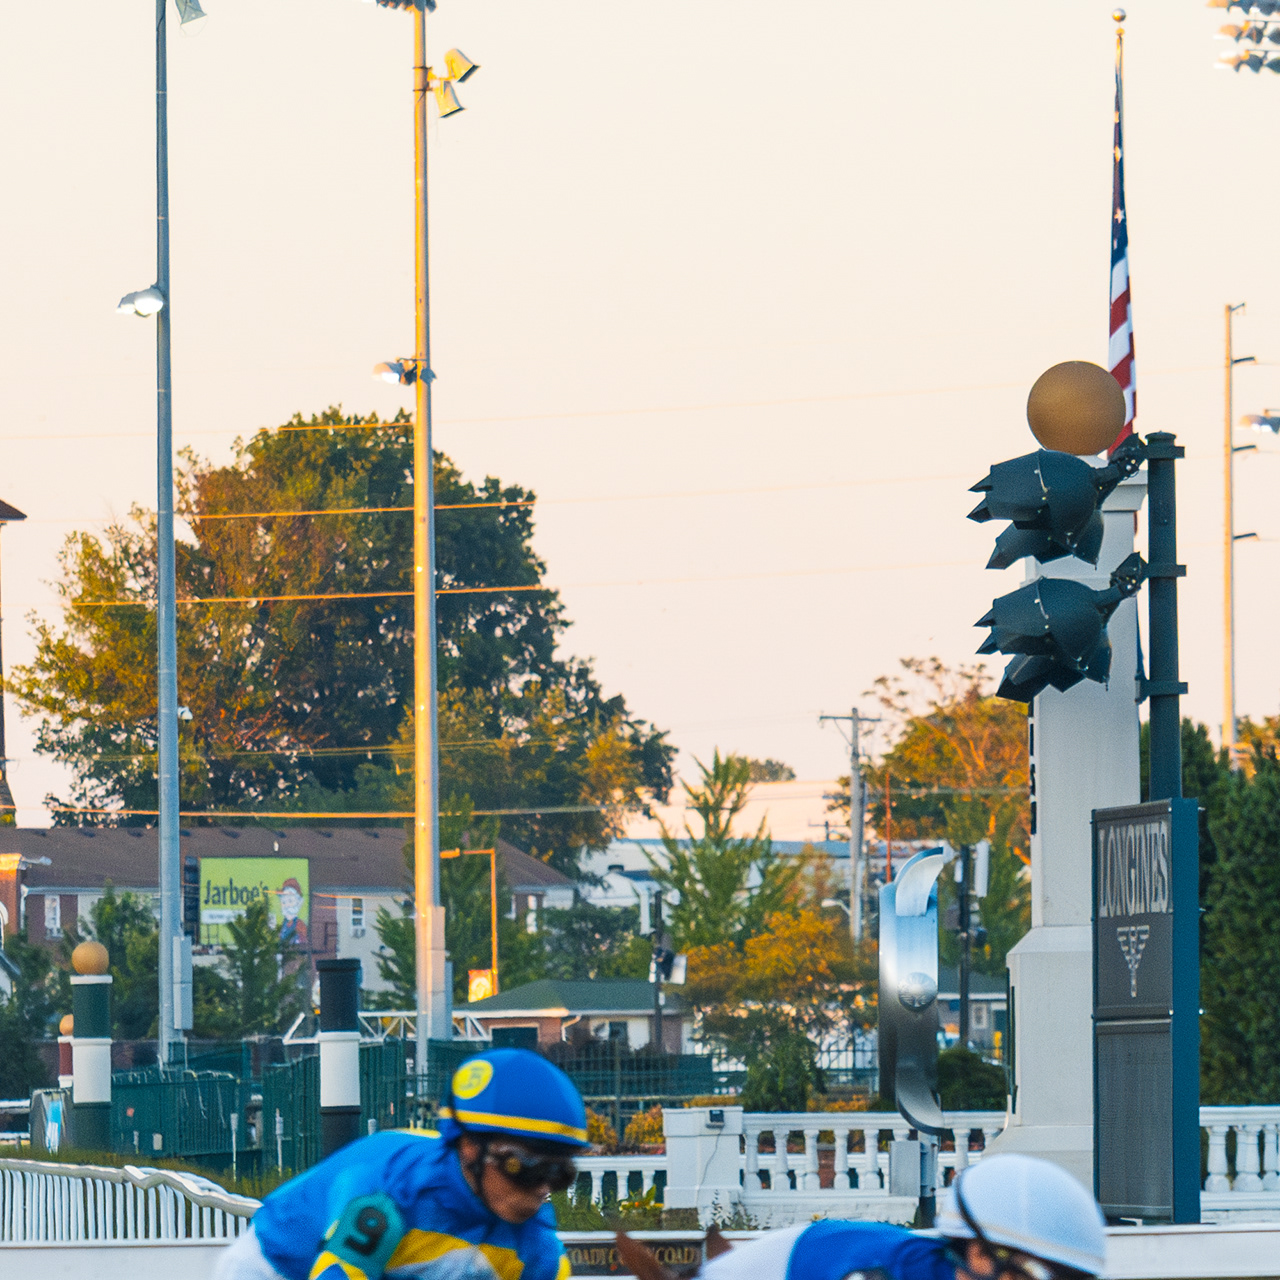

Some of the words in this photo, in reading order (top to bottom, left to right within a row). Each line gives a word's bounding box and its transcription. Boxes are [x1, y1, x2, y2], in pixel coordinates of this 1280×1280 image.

[204, 877, 269, 906] Jarboe's
[1098, 820, 1170, 919] LONGINES
[344, 1205, 388, 1257] 9
